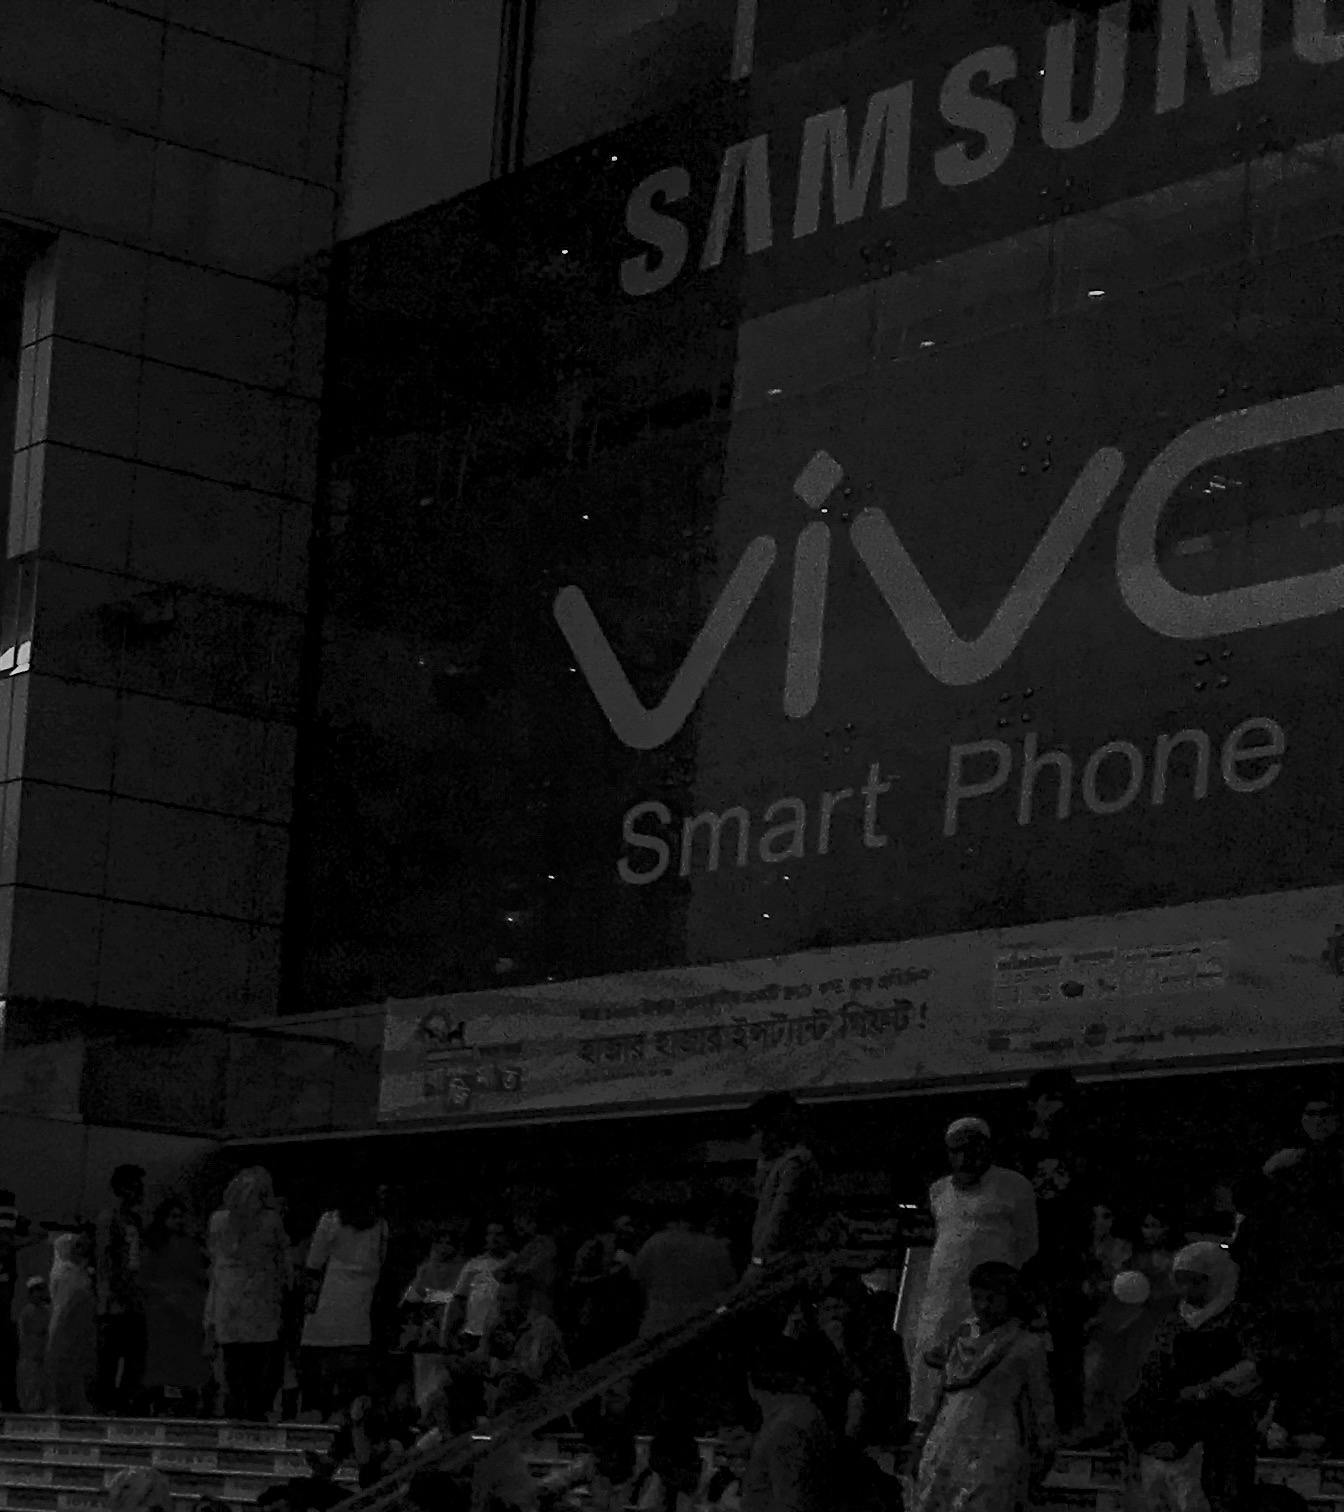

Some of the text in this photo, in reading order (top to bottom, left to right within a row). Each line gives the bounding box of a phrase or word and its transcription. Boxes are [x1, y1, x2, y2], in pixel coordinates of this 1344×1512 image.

[619, 0, 1344, 296] SAMSUN
[615, 715, 1285, 885] Smart Phone
